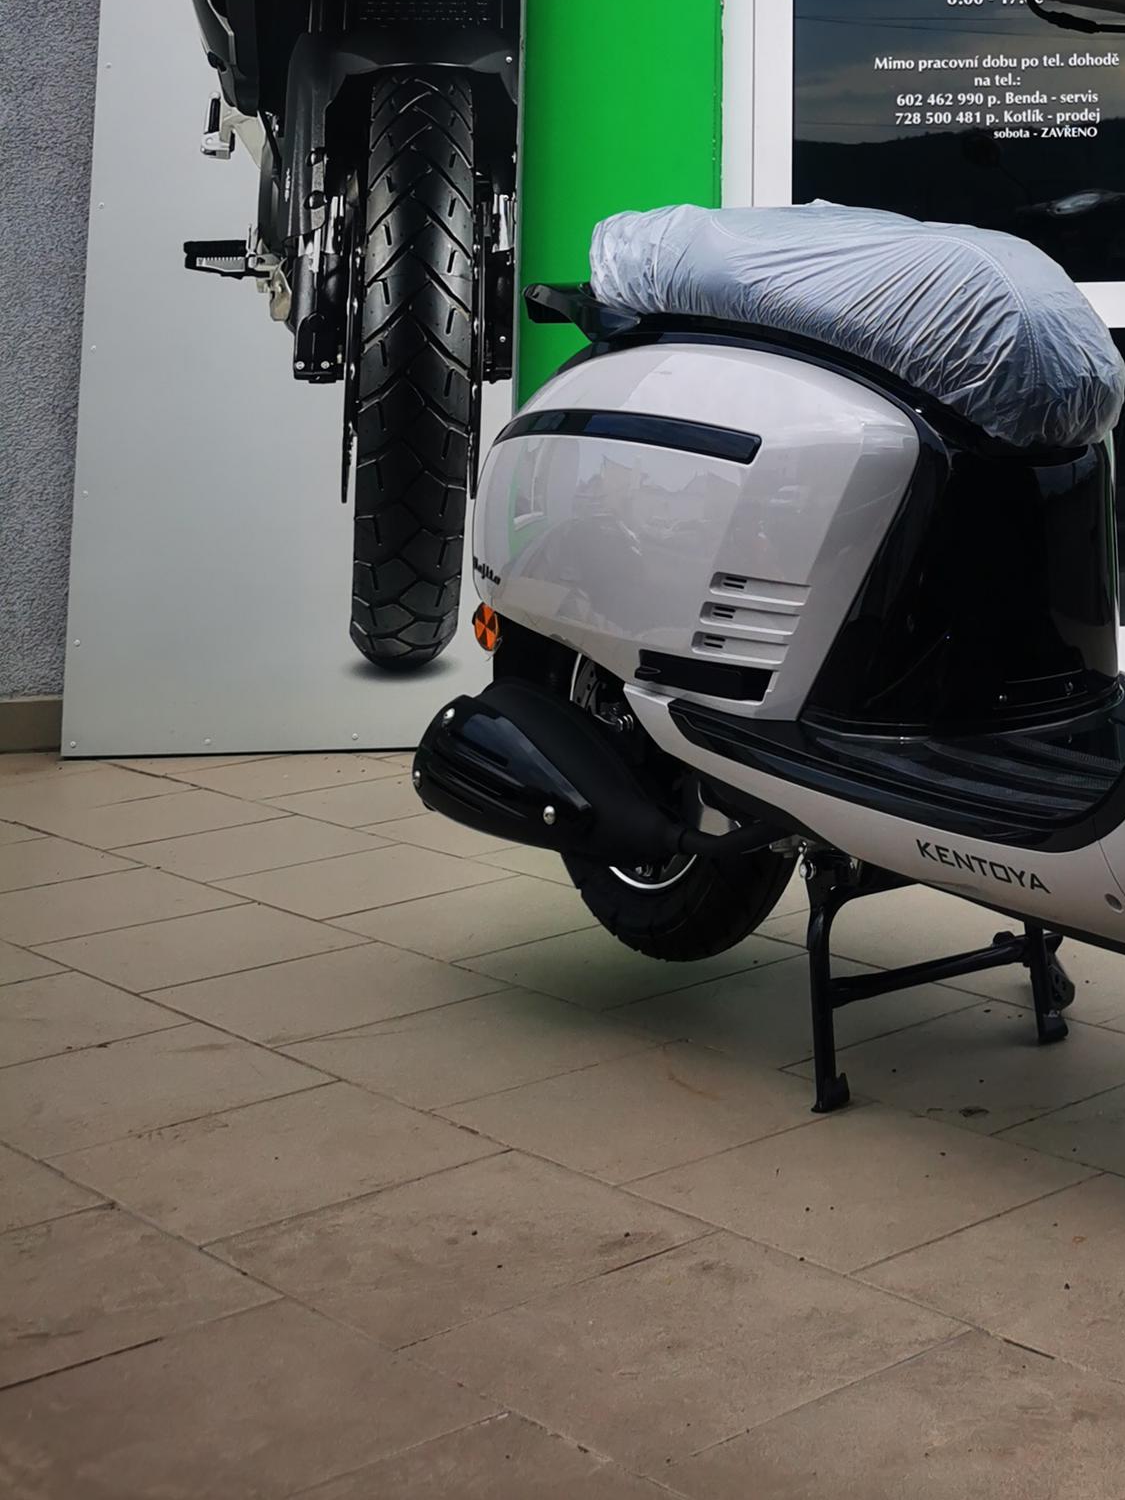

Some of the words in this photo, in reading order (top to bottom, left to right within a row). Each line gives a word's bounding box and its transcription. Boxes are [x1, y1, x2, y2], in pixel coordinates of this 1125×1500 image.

[874, 56, 915, 70] Mimo
[918, 55, 979, 73] pracovní
[982, 54, 1019, 69] dobu
[1021, 58, 1039, 72] po
[1042, 54, 1064, 67] tel.
[1068, 52, 1120, 67] dohodě
[973, 75, 991, 87] na
[994, 73, 1022, 87] tel.:
[896, 94, 923, 106] 602
[926, 93, 954, 106] 462
[957, 92, 984, 105] 990
[987, 95, 1001, 109] p.
[1005, 91, 1048, 105] Benda
[1060, 90, 1099, 103] servis
[895, 112, 922, 125] 728
[925, 112, 952, 124] 500
[955, 111, 981, 124] 481
[986, 113, 1000, 127] p.
[1003, 109, 1044, 124] Kotlík
[1056, 109, 1101, 125] prodej
[993, 126, 1030, 139] sobota
[1041, 124, 1099, 138] ZAVŘENO
[915, 838, 1052, 895] KENTOYA
